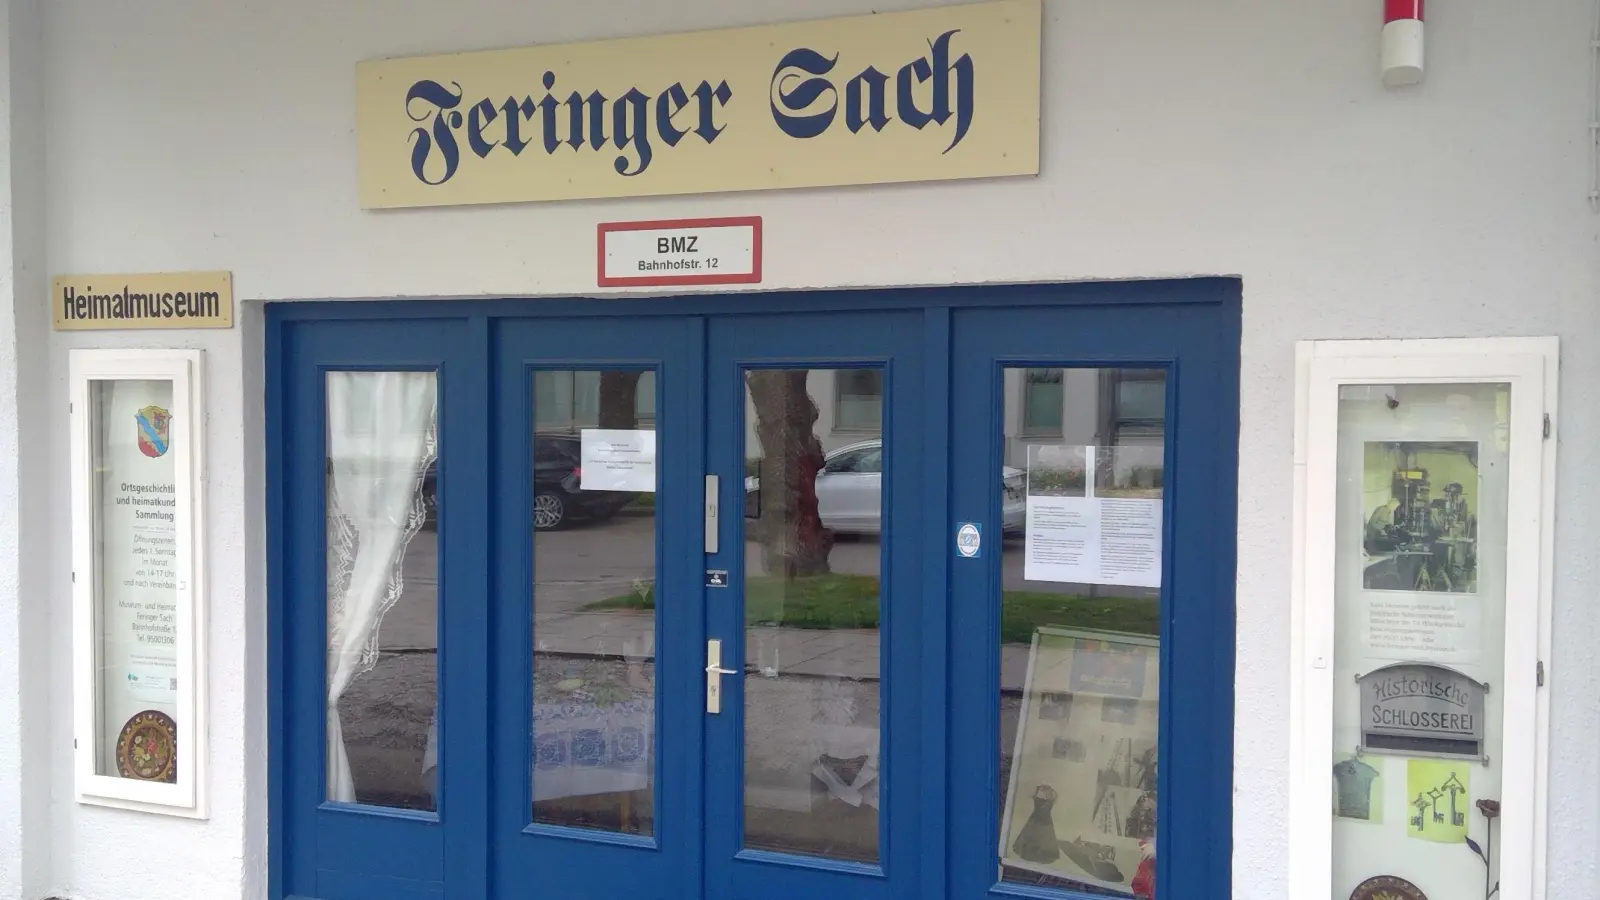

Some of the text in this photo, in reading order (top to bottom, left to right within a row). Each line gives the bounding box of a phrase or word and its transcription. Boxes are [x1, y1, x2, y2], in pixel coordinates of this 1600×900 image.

[405, 29, 975, 185] Feringer Sach
[657, 236, 698, 253] BMZ
[638, 258, 719, 271] Bahnhofstr. 12
[116, 496, 130, 505] und
[135, 509, 174, 522] Sammlung
[1372, 675, 1469, 705] Historische
[1372, 705, 1473, 730] SCHLOSSEREI
